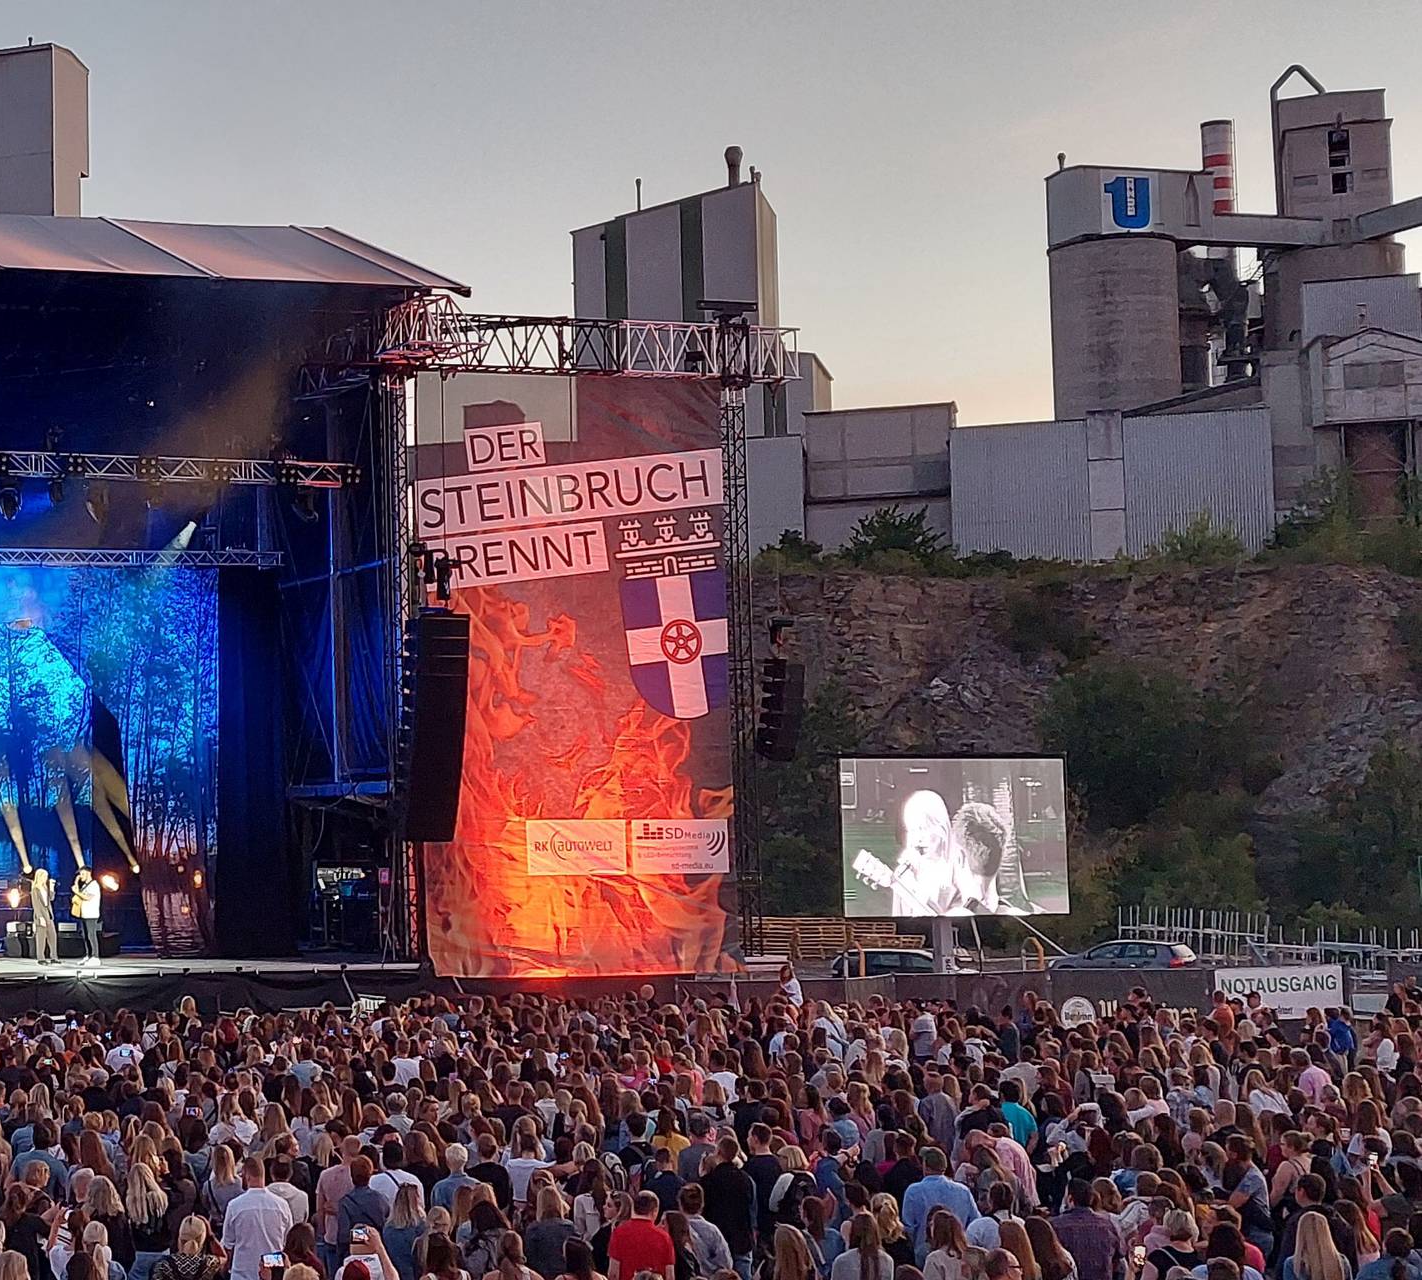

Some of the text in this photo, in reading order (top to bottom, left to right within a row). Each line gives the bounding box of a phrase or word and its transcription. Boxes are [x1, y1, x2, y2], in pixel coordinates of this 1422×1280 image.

[469, 429, 540, 464] DER
[420, 460, 710, 528] STEINBRUCH
[665, 828, 683, 840] SD
[534, 841, 548, 852] RK
[1221, 975, 1337, 994] NOTAUSGANG
